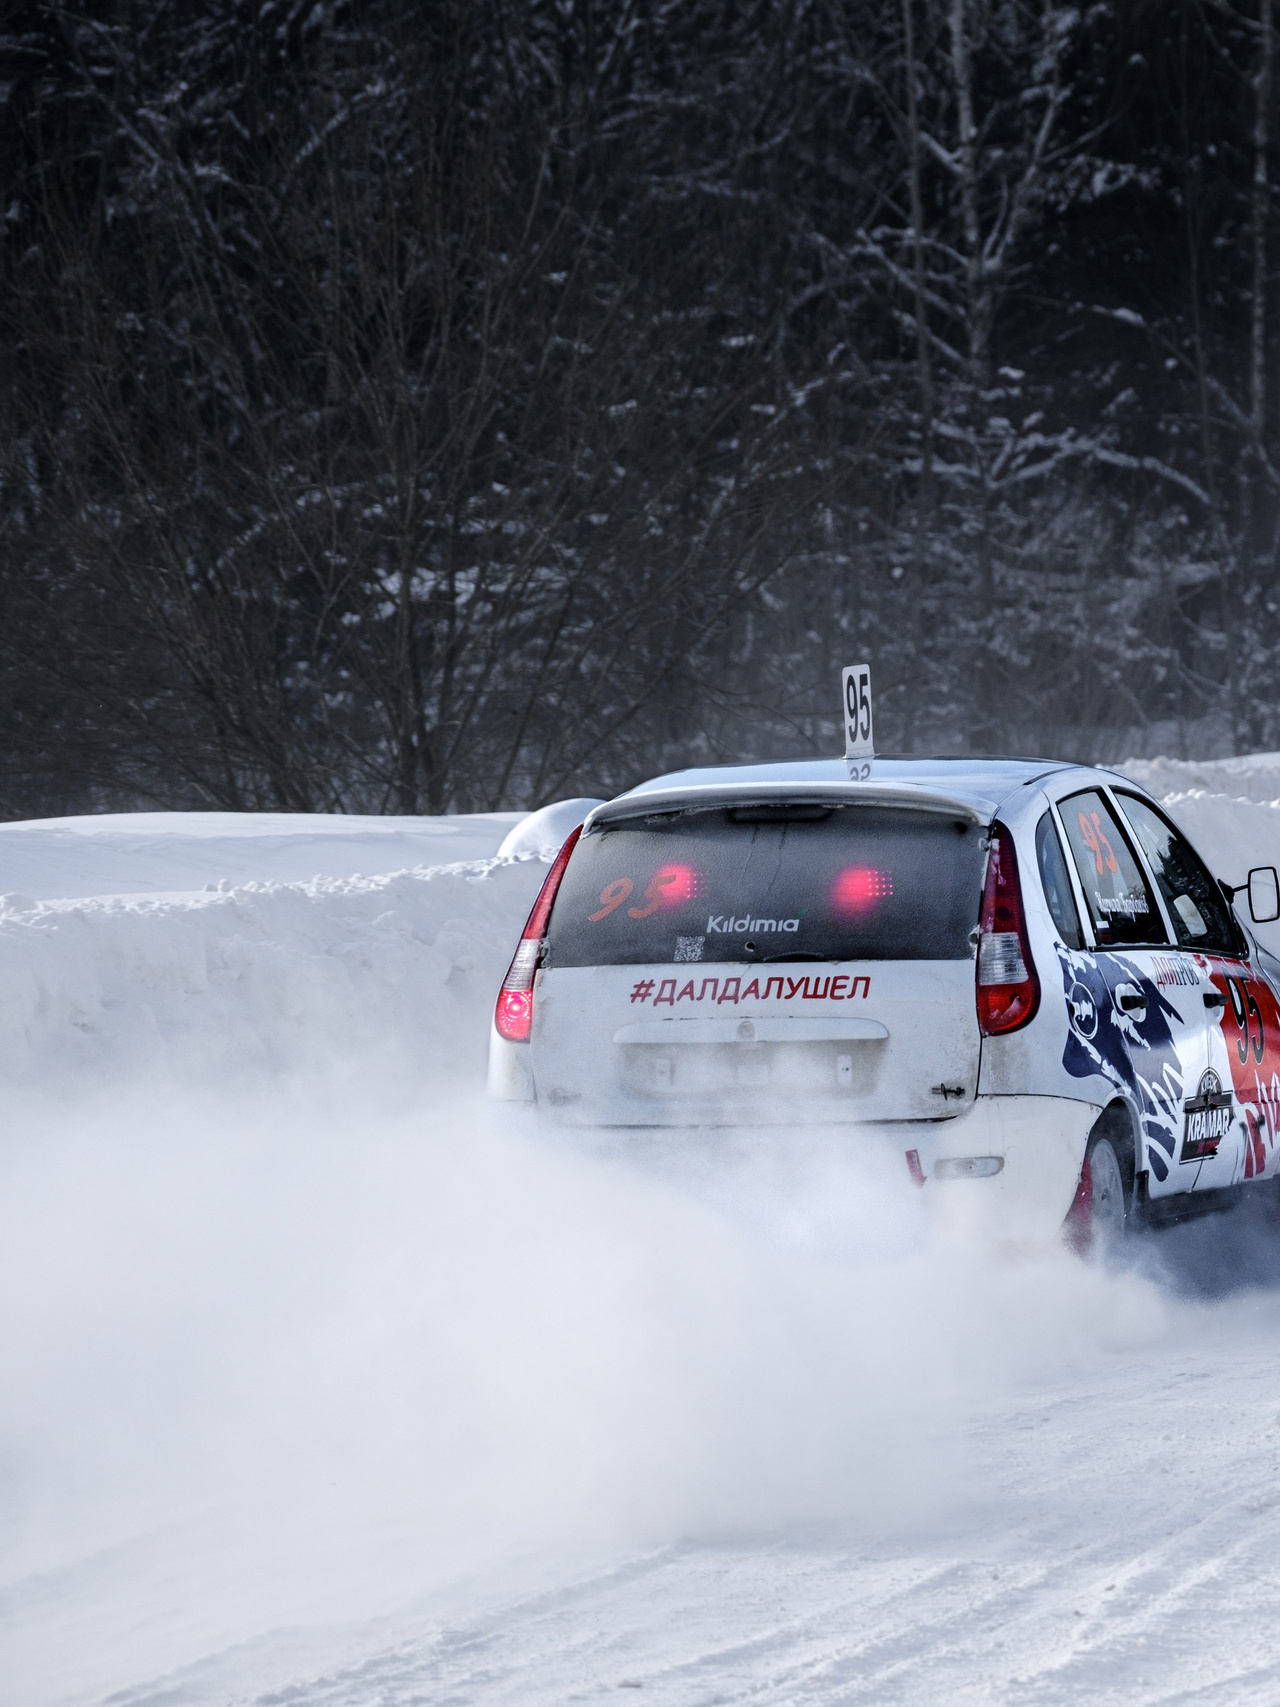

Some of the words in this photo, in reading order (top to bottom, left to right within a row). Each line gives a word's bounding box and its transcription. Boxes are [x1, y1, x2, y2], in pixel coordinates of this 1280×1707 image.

[846, 673, 870, 743] 95
[1078, 811, 1117, 875] 95
[589, 873, 677, 922] 95
[630, 976, 871, 1006] #ДАЛДАЛУШЕЛ
[1221, 965, 1264, 1065] 95
[1187, 1108, 1230, 1142] KRAMAR
